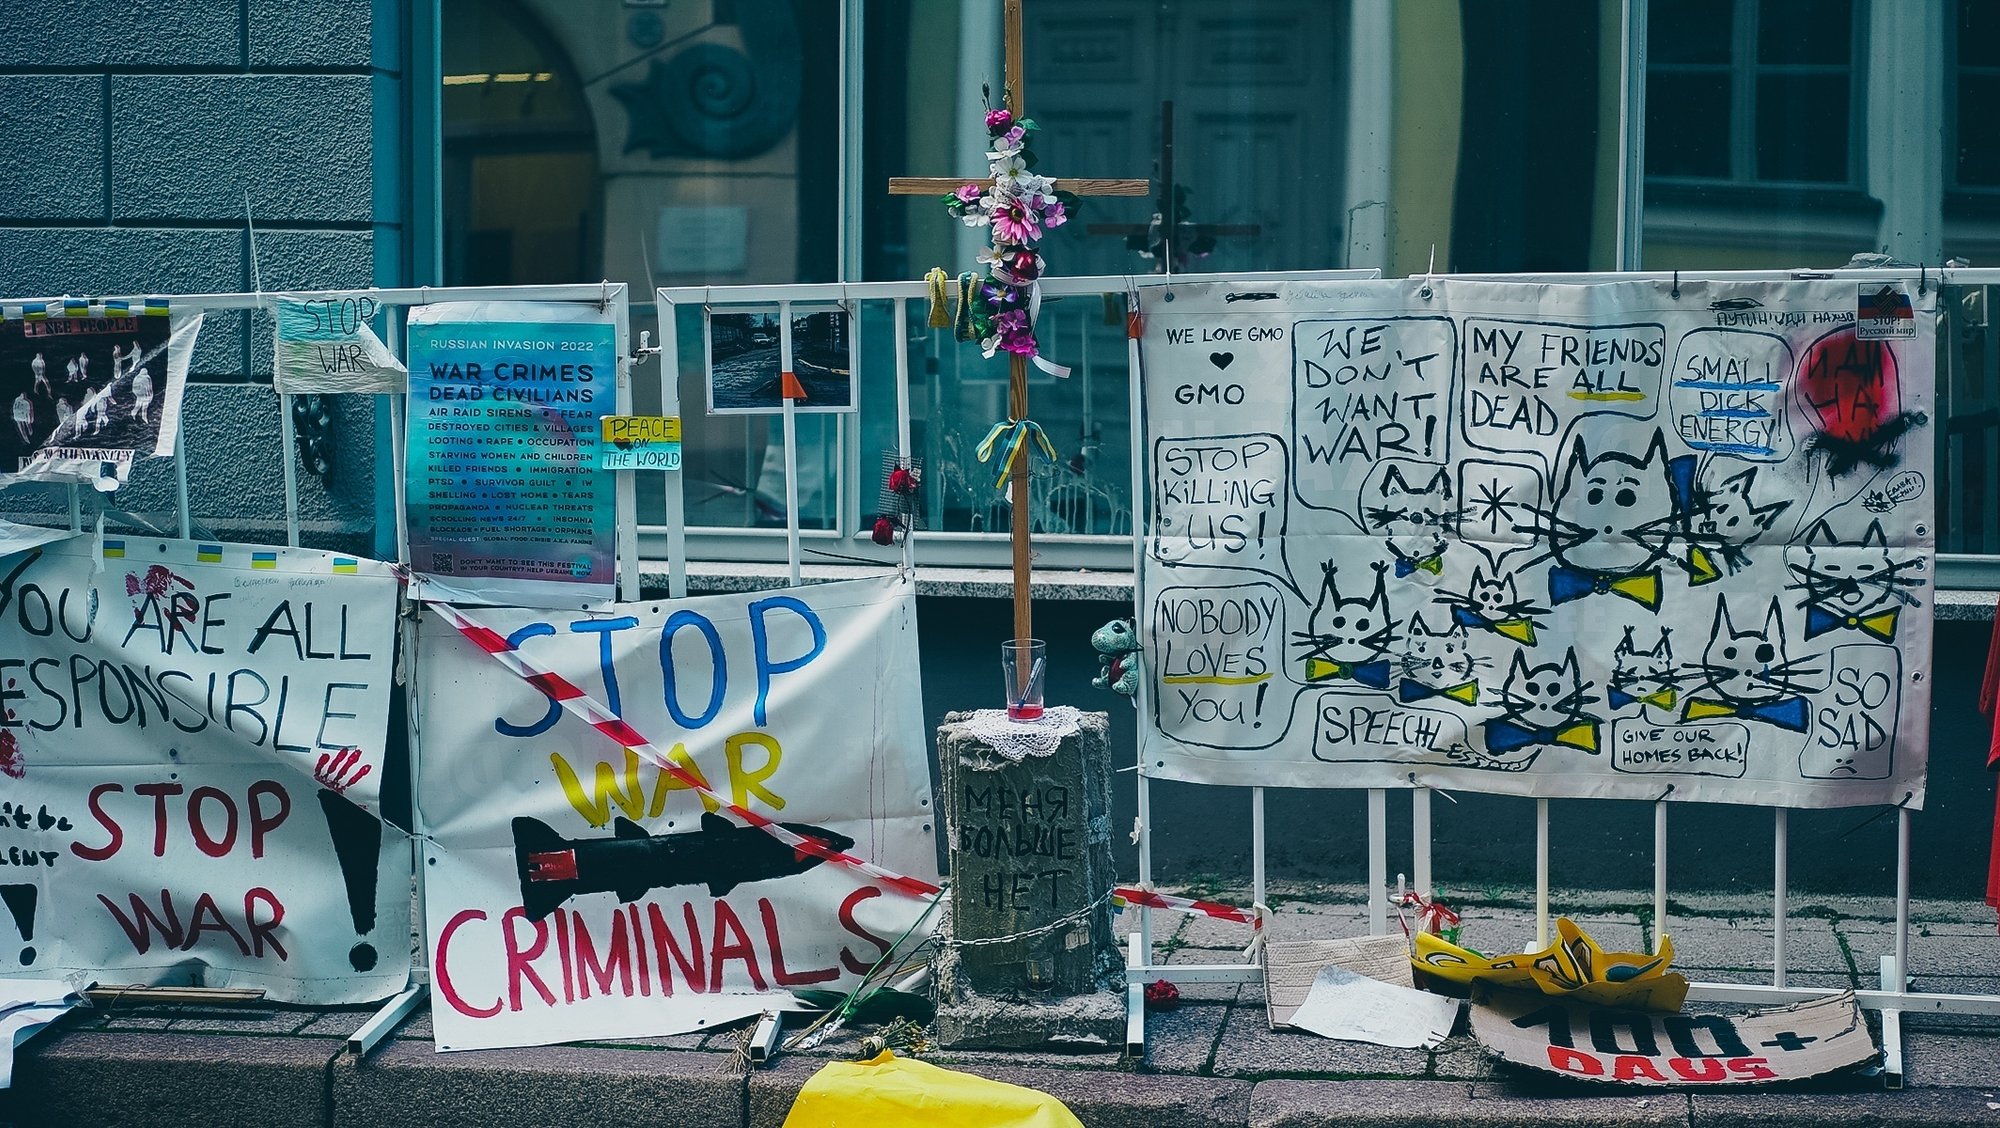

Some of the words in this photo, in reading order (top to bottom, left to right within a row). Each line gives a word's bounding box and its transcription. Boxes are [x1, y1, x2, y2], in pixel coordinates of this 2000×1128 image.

[79, 315, 134, 332] PEOPLE
[303, 297, 375, 336] STOP
[430, 339, 488, 350] RUSSIAN
[493, 340, 555, 351] INVASION
[560, 341, 594, 351] 2022
[1166, 327, 1194, 345] WE
[1202, 327, 1243, 343] LOVE
[1247, 326, 1284, 343] GMO
[1316, 324, 1391, 360] WE
[1472, 326, 1524, 356] MY
[317, 344, 366, 373] WAR
[1302, 350, 1440, 389] DON'T
[1681, 354, 1784, 385] SMALL
[429, 362, 482, 381] WAR
[494, 363, 594, 383] CRIMES
[1479, 362, 1558, 390] ARE
[1571, 369, 1641, 395] ALL
[429, 386, 484, 402] DEAD
[492, 387, 593, 403] CIVILIANS
[1174, 383, 1245, 405] GMO
[1700, 391, 1765, 413] DICK
[429, 407, 450, 418] AIR
[453, 407, 482, 418] RAID
[486, 408, 532, 419] SIRENS
[561, 409, 593, 419] FEAR
[1314, 392, 1439, 425] WANT
[1470, 389, 1560, 436] DEAD
[428, 422, 490, 432] DESTROYED
[494, 423, 529, 433] CITIES
[533, 423, 540, 433] &
[543, 424, 594, 434] VILLAGES
[610, 418, 674, 438] PEACE
[1301, 414, 1438, 465] WAR!
[1680, 408, 1783, 450] ENERGY!
[60, 448, 133, 460] HUMANITY
[428, 436, 474, 446] LOOTING
[486, 437, 514, 446] RAPE
[527, 437, 595, 448] OCCUPATION
[633, 437, 650, 449] ON
[428, 451, 477, 461] STARVING
[480, 451, 516, 461] WOMEN
[520, 452, 541, 461] AND
[544, 452, 593, 462] CHILDREN
[428, 465, 463, 474] KILLED
[465, 465, 508, 474] FRIENDS
[529, 466, 593, 475] IMMIGRATION
[603, 451, 631, 467] THE
[636, 451, 680, 468] WORLD
[1165, 441, 1270, 476] STOP
[428, 478, 455, 487] PTSD
[475, 478, 525, 487] SURVIVOR
[528, 479, 557, 488] GUILT
[428, 491, 477, 500] SHELLING
[491, 491, 517, 500] LOST
[520, 491, 549, 500] HOME
[562, 491, 594, 500] TEARS
[428, 503, 490, 512] PROPAGANDA
[505, 504, 549, 512] NUCLEAR
[552, 504, 594, 513] THREATS
[429, 515, 478, 523] SCROLLING
[480, 515, 505, 523] NEWS
[507, 515, 527, 523] 24/7
[553, 516, 593, 525] INSOMNIA
[429, 526, 473, 534] BLOCKADE
[480, 526, 501, 534] FUEL
[503, 526, 547, 535] SHORTAGE
[554, 527, 593, 536] ORPHANS
[491, 565, 525, 573] COUNTRY?
[526, 566, 544, 574] HELP
[545, 568, 573, 576] UKRAINE
[538, 560, 555, 568] THIS
[557, 561, 592, 570] FESTIVAL
[121, 592, 232, 655] ARE
[246, 599, 372, 661] ALL
[1160, 596, 1278, 641] NOBODY
[495, 595, 828, 738] STOP
[1163, 642, 1267, 677] LOVES
[1836, 667, 1891, 711] SO
[1622, 728, 1663, 744] GIVE
[1673, 728, 1716, 744] OUR
[1818, 707, 1887, 752] SAD
[1622, 748, 1682, 766] HOMES
[1687, 741, 1745, 765] BACK!
[550, 732, 786, 828] WAR
[964, 784, 1069, 824] МЕНЯ
[70, 780, 291, 862] STOP
[959, 823, 1077, 861] БОЛЬШЕ
[983, 868, 1073, 912] НЕТ
[97, 886, 288, 962] WAR
[436, 886, 894, 1019] CRIMINALS
